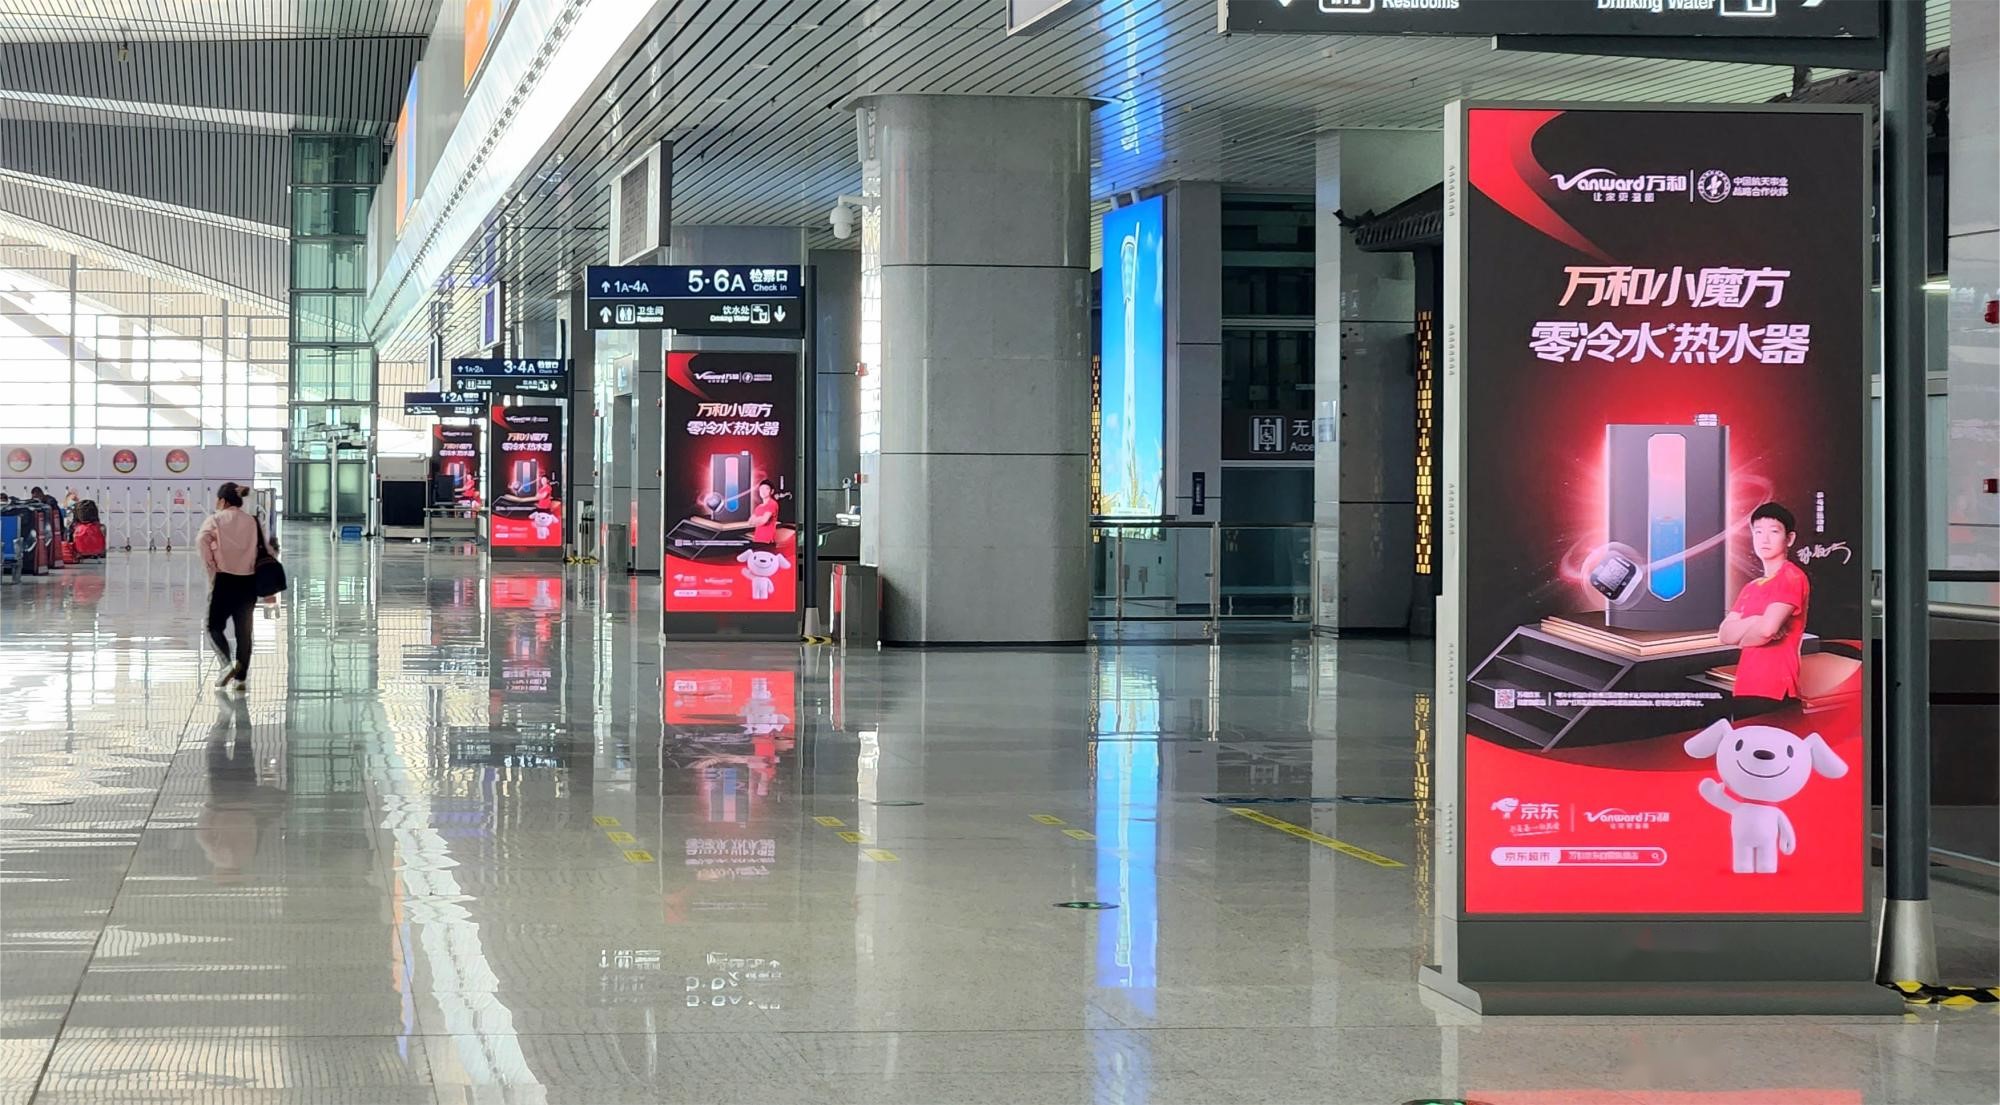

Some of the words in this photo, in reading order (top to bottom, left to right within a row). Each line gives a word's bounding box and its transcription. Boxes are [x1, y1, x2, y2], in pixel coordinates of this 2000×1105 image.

[1549, 168, 1645, 192] Vanward
[1646, 175, 1687, 192] 万和
[749, 269, 788, 283] 检票口
[614, 280, 649, 293] 1A-4A
[1558, 265, 1791, 308] 万和小魔方
[637, 306, 664, 315] 卫生间
[722, 305, 750, 315] 饮水处
[696, 403, 773, 417] 万和小魔方
[1292, 419, 1315, 437] 无
[1290, 442, 1315, 451] Acce
[1520, 803, 1560, 821] 京东
[1504, 852, 1551, 862] 京东超市
